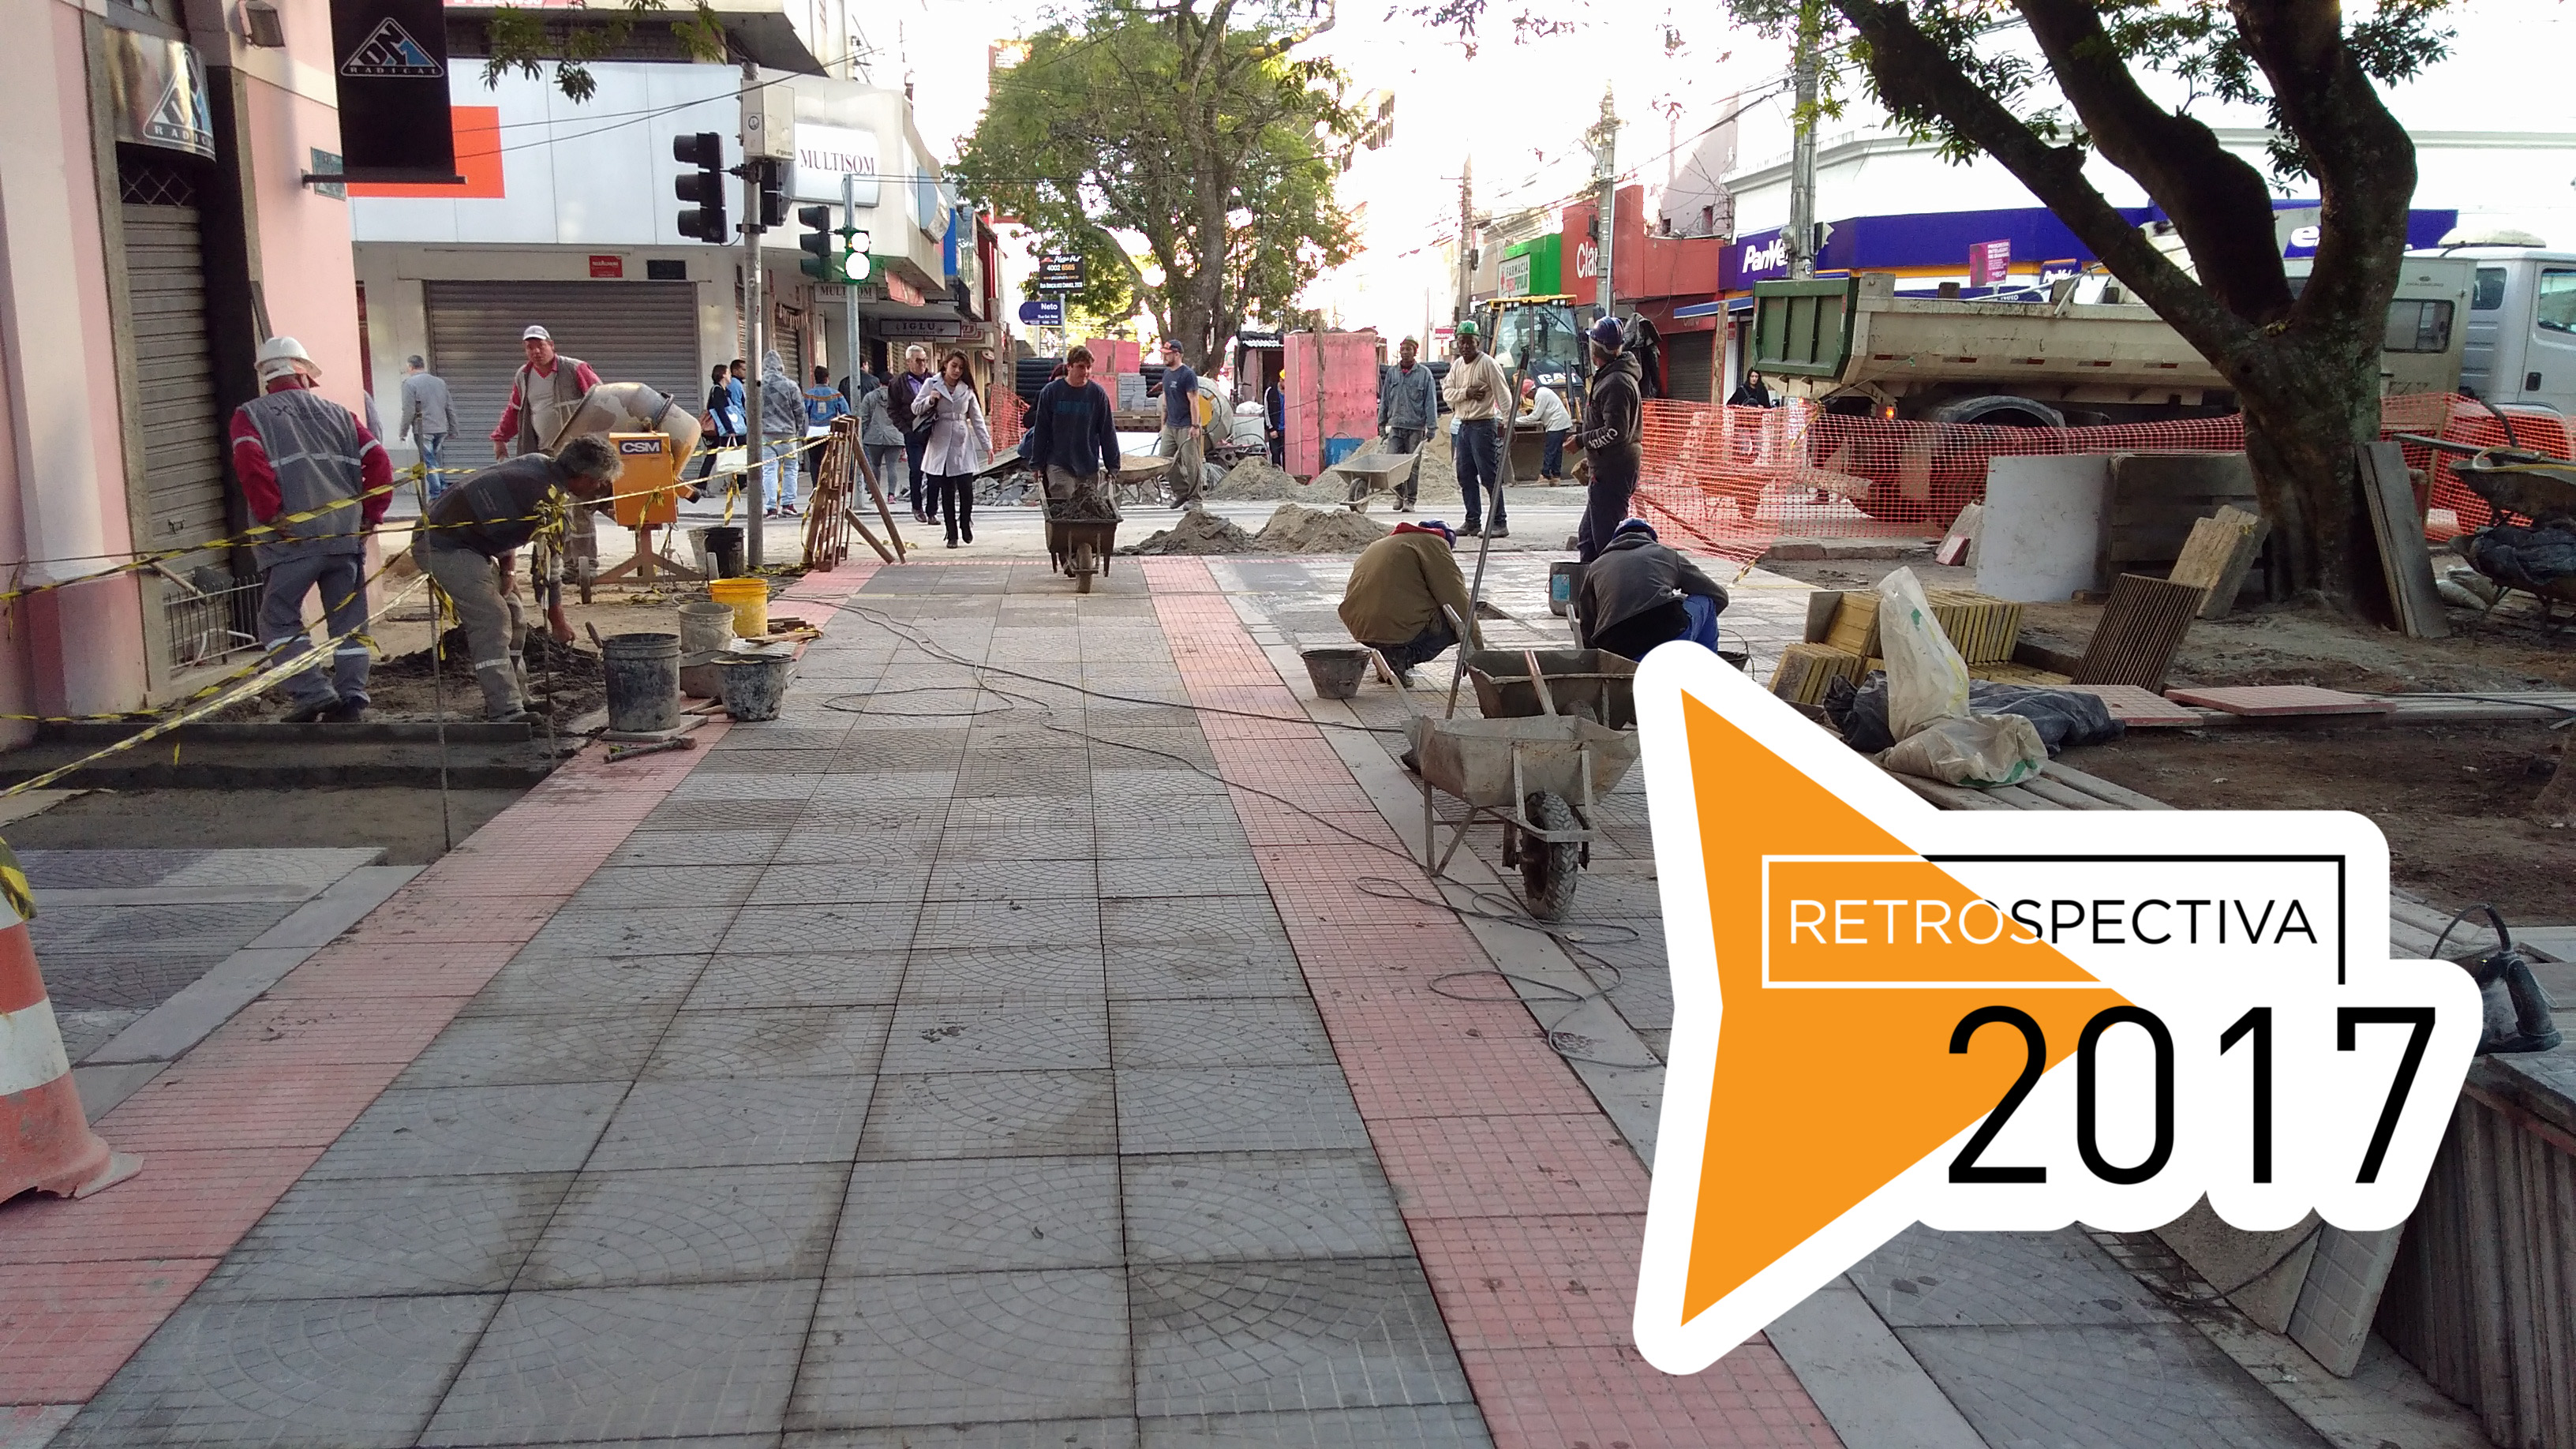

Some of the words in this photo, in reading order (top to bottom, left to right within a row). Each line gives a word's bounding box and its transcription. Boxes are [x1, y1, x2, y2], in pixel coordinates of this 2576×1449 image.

[800, 149, 875, 175] MULTISOM
[820, 285, 872, 297] MULTOM
[902, 322, 936, 331] IGLU
[621, 442, 661, 453] CSM
